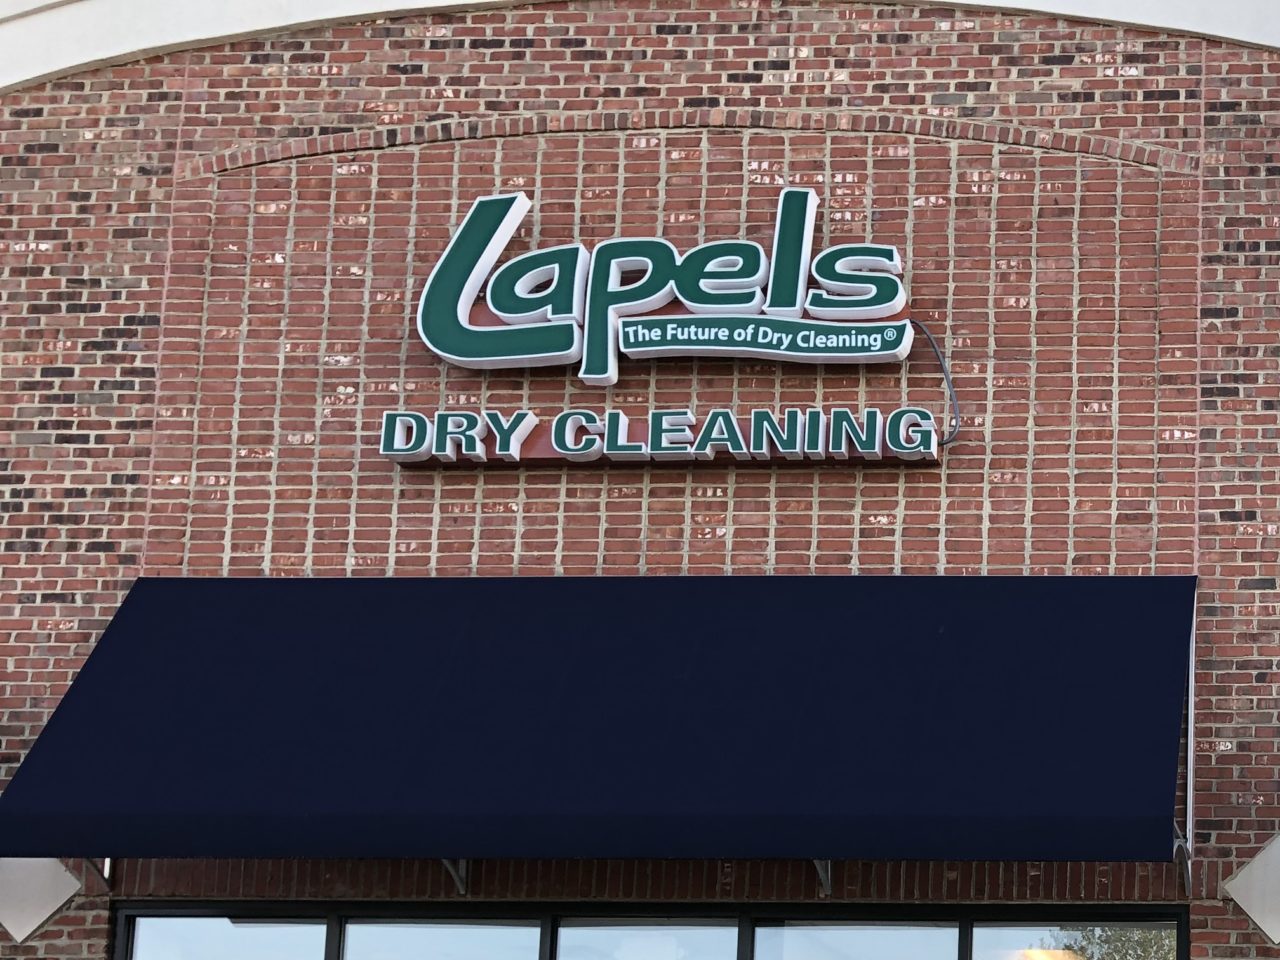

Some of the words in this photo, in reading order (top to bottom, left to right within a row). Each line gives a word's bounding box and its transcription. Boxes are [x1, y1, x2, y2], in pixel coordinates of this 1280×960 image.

[416, 187, 910, 386] Lapels
[624, 325, 662, 344] The
[665, 323, 730, 342] Future
[732, 324, 754, 342] of
[757, 326, 793, 350] Dry
[380, 409, 539, 462] DRY
[551, 407, 941, 462] CLEANING
